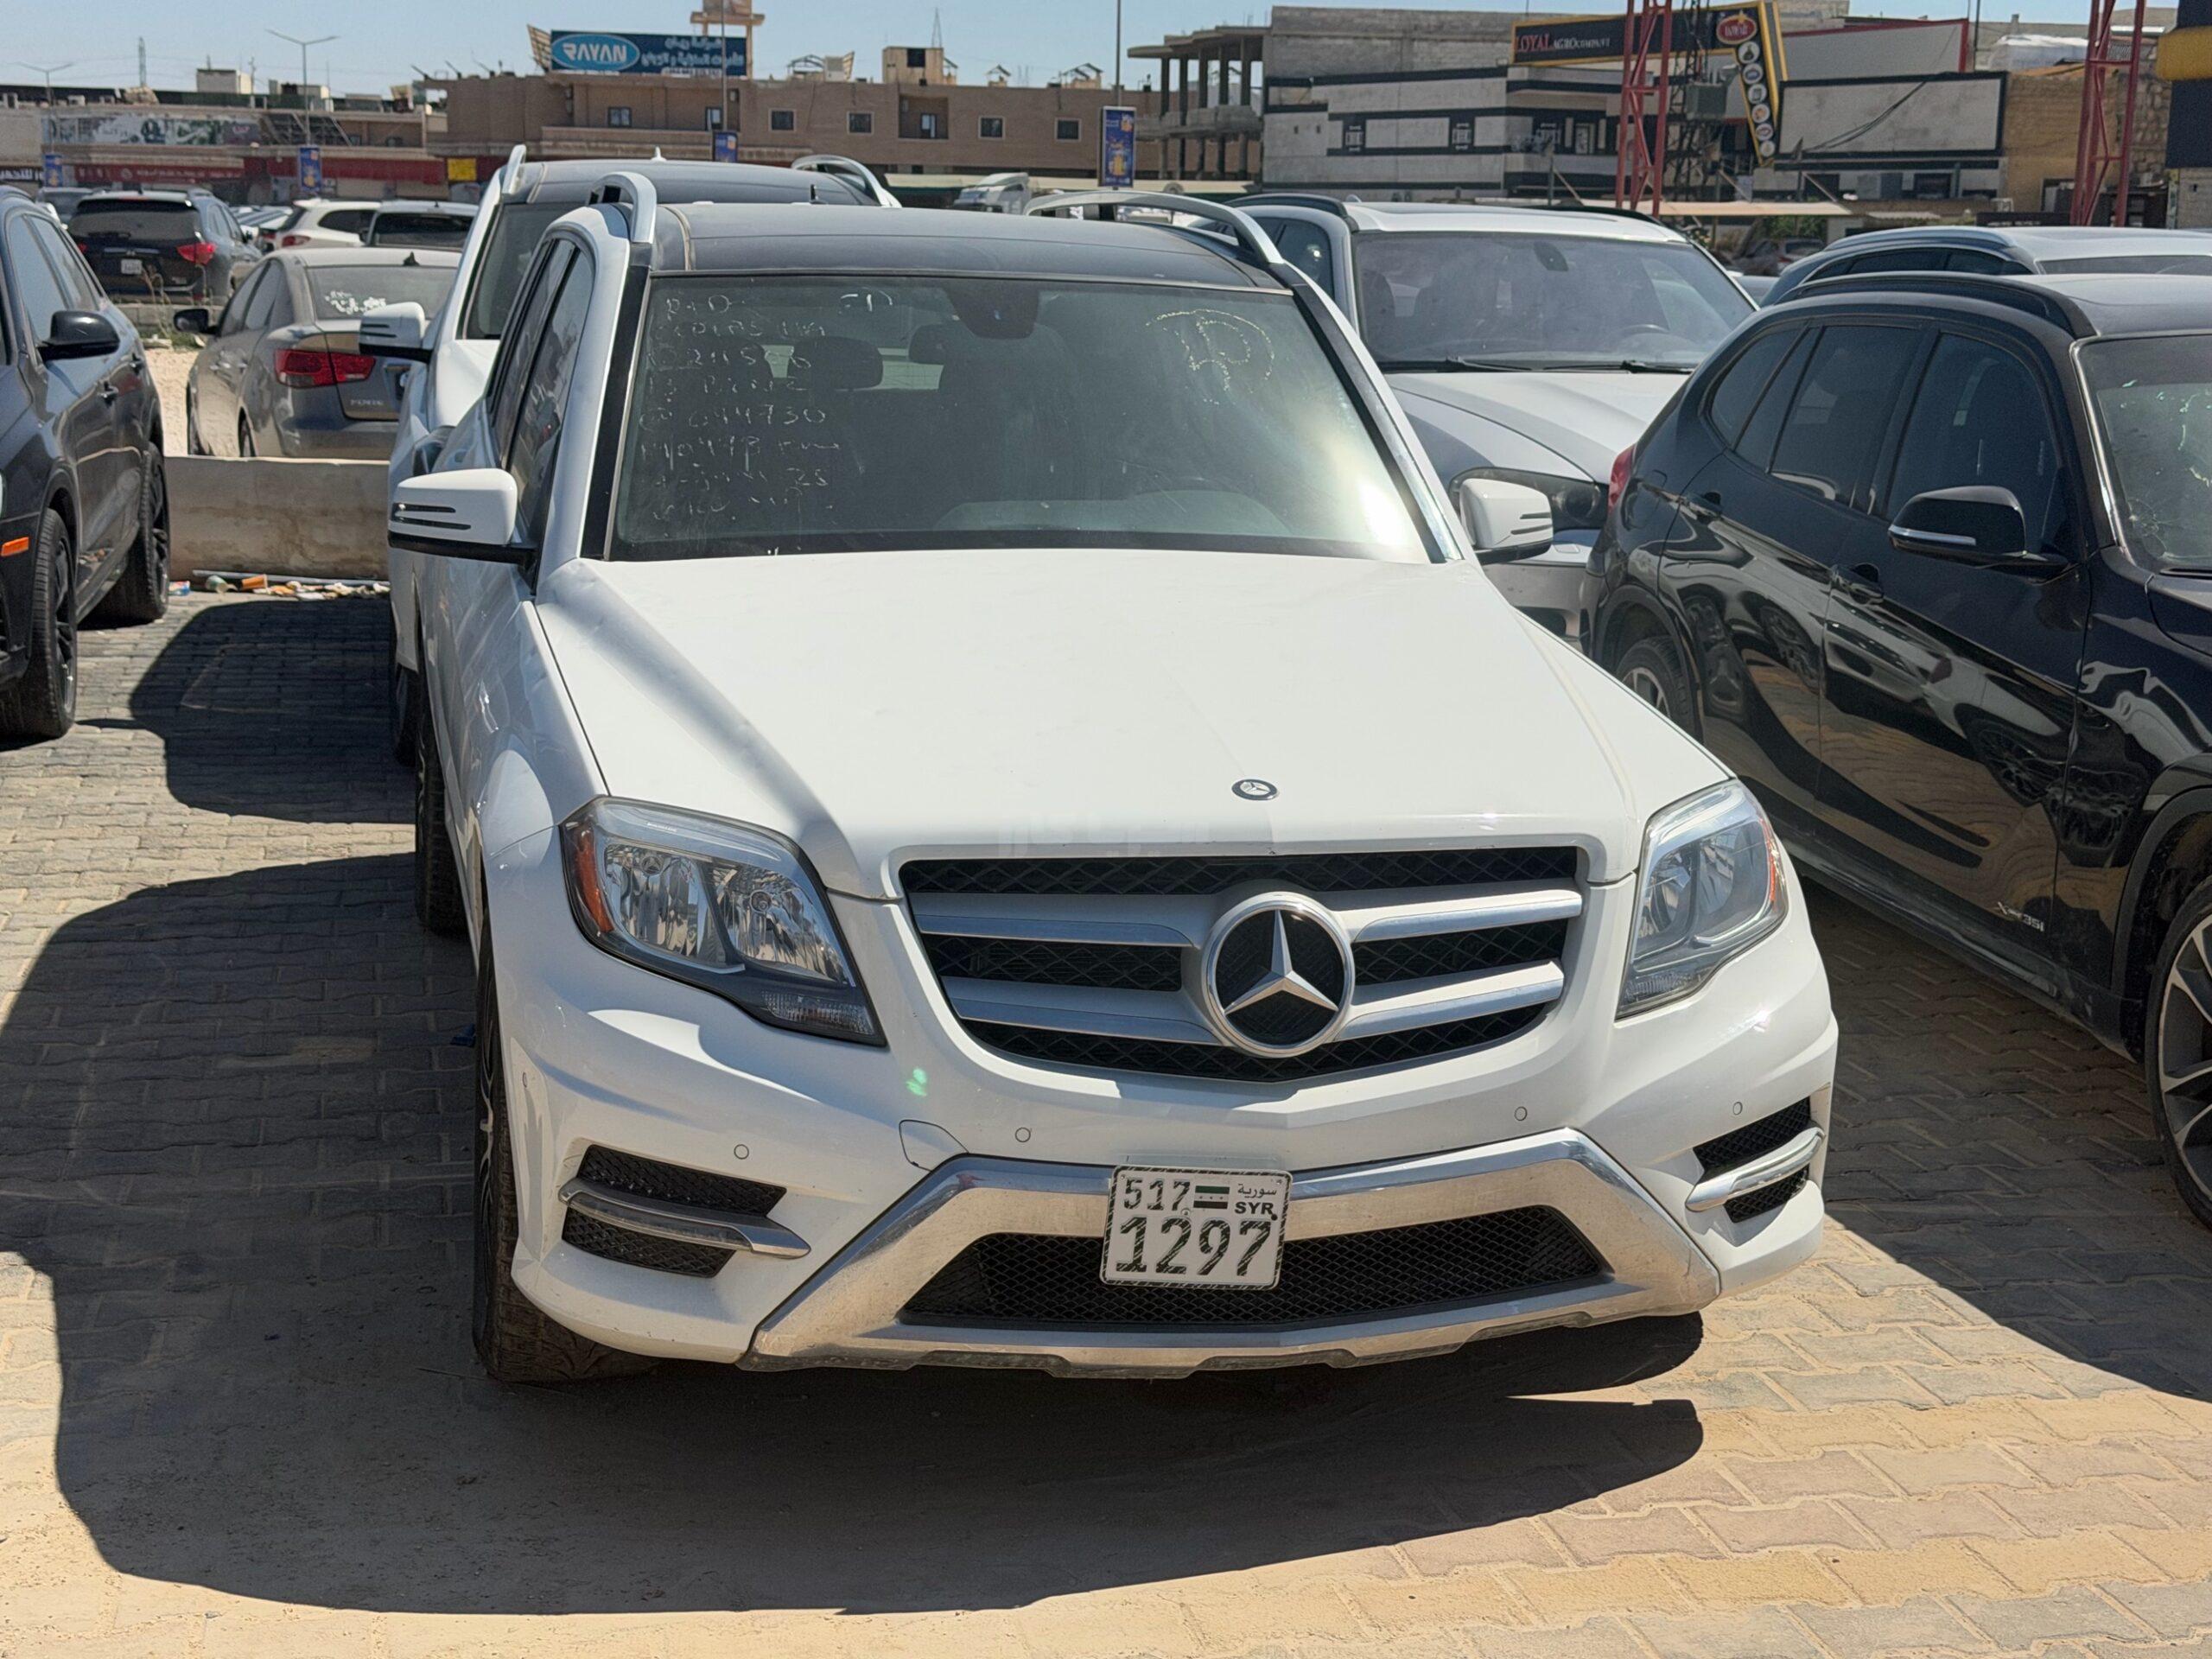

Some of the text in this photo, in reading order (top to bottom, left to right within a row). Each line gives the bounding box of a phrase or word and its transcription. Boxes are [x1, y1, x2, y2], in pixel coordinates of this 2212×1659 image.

[563, 42, 627, 63] RAYAN
[1123, 1179, 1191, 1211] 517
[1237, 1183, 1277, 1199] سورية
[1235, 1202, 1274, 1215] SYR
[1116, 1217, 1271, 1276] 1297
